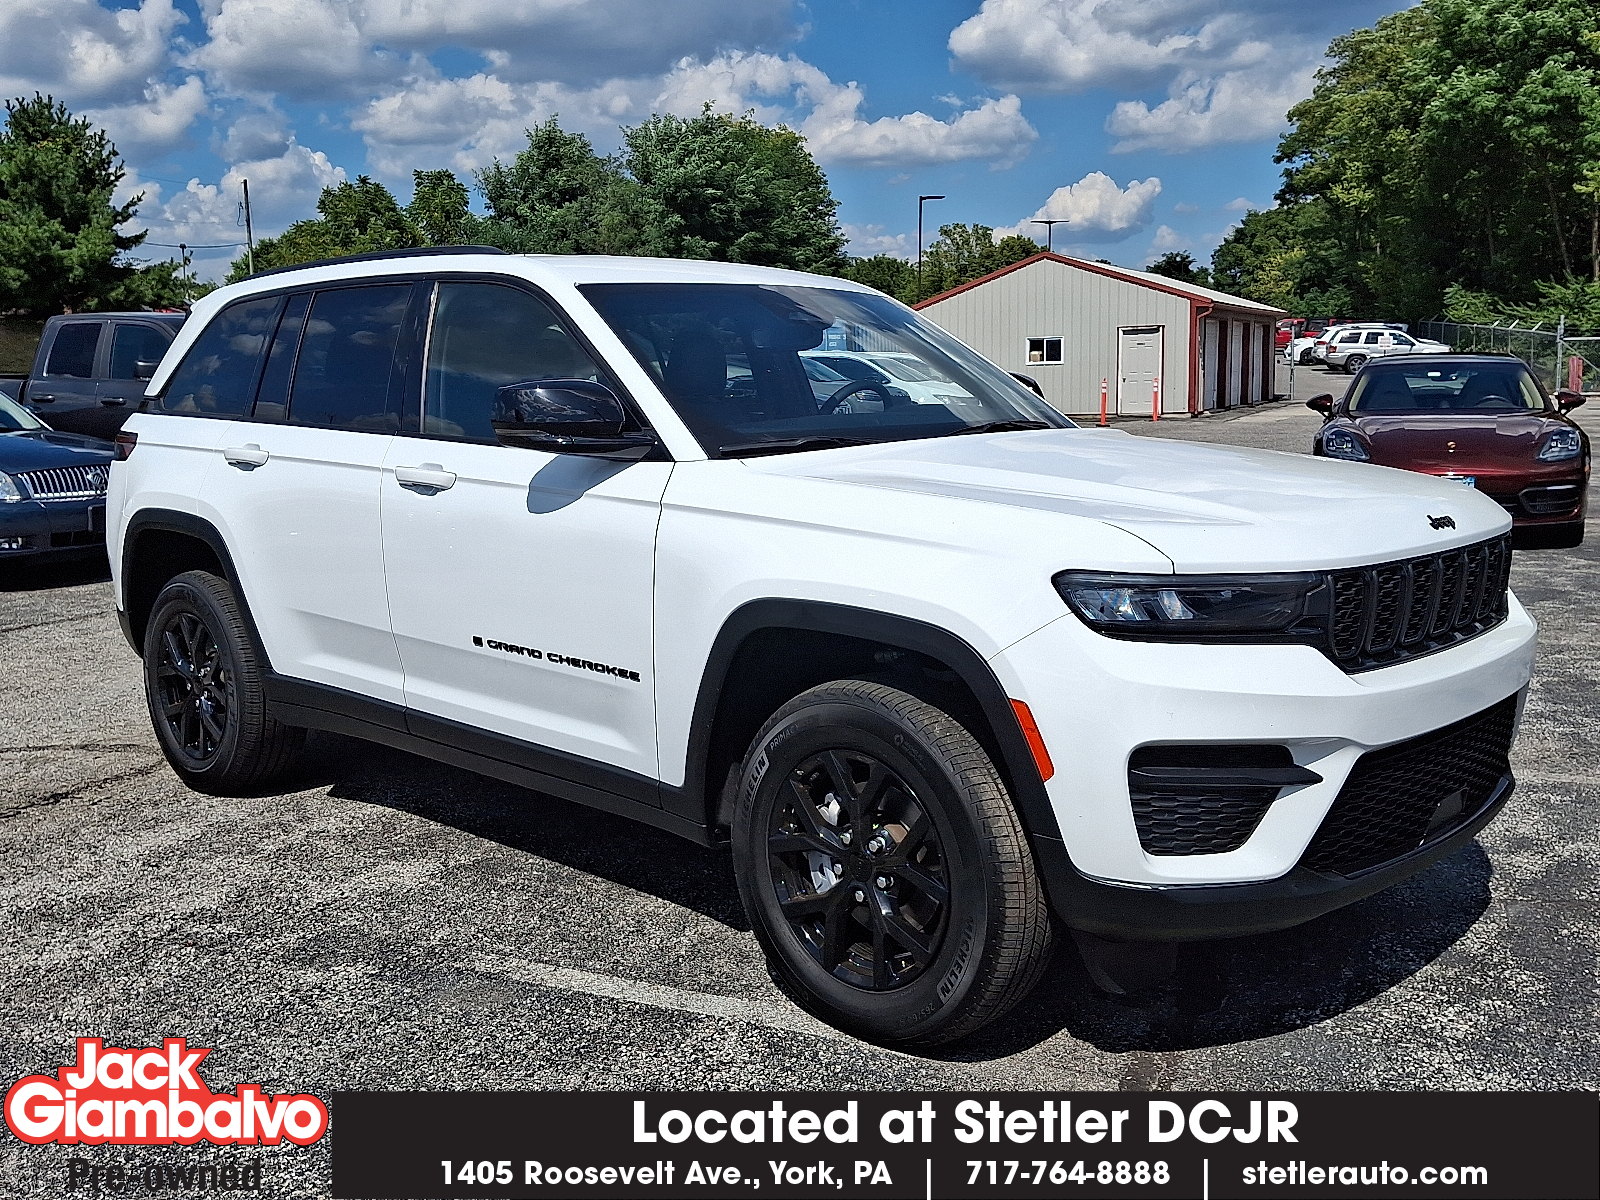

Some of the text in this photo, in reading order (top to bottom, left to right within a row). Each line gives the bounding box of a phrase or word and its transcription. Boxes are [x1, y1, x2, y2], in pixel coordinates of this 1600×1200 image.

[1426, 514, 1456, 530] Jeep
[486, 639, 641, 683] GRAND CHEROKEE
[742, 755, 767, 820] CHELIN
